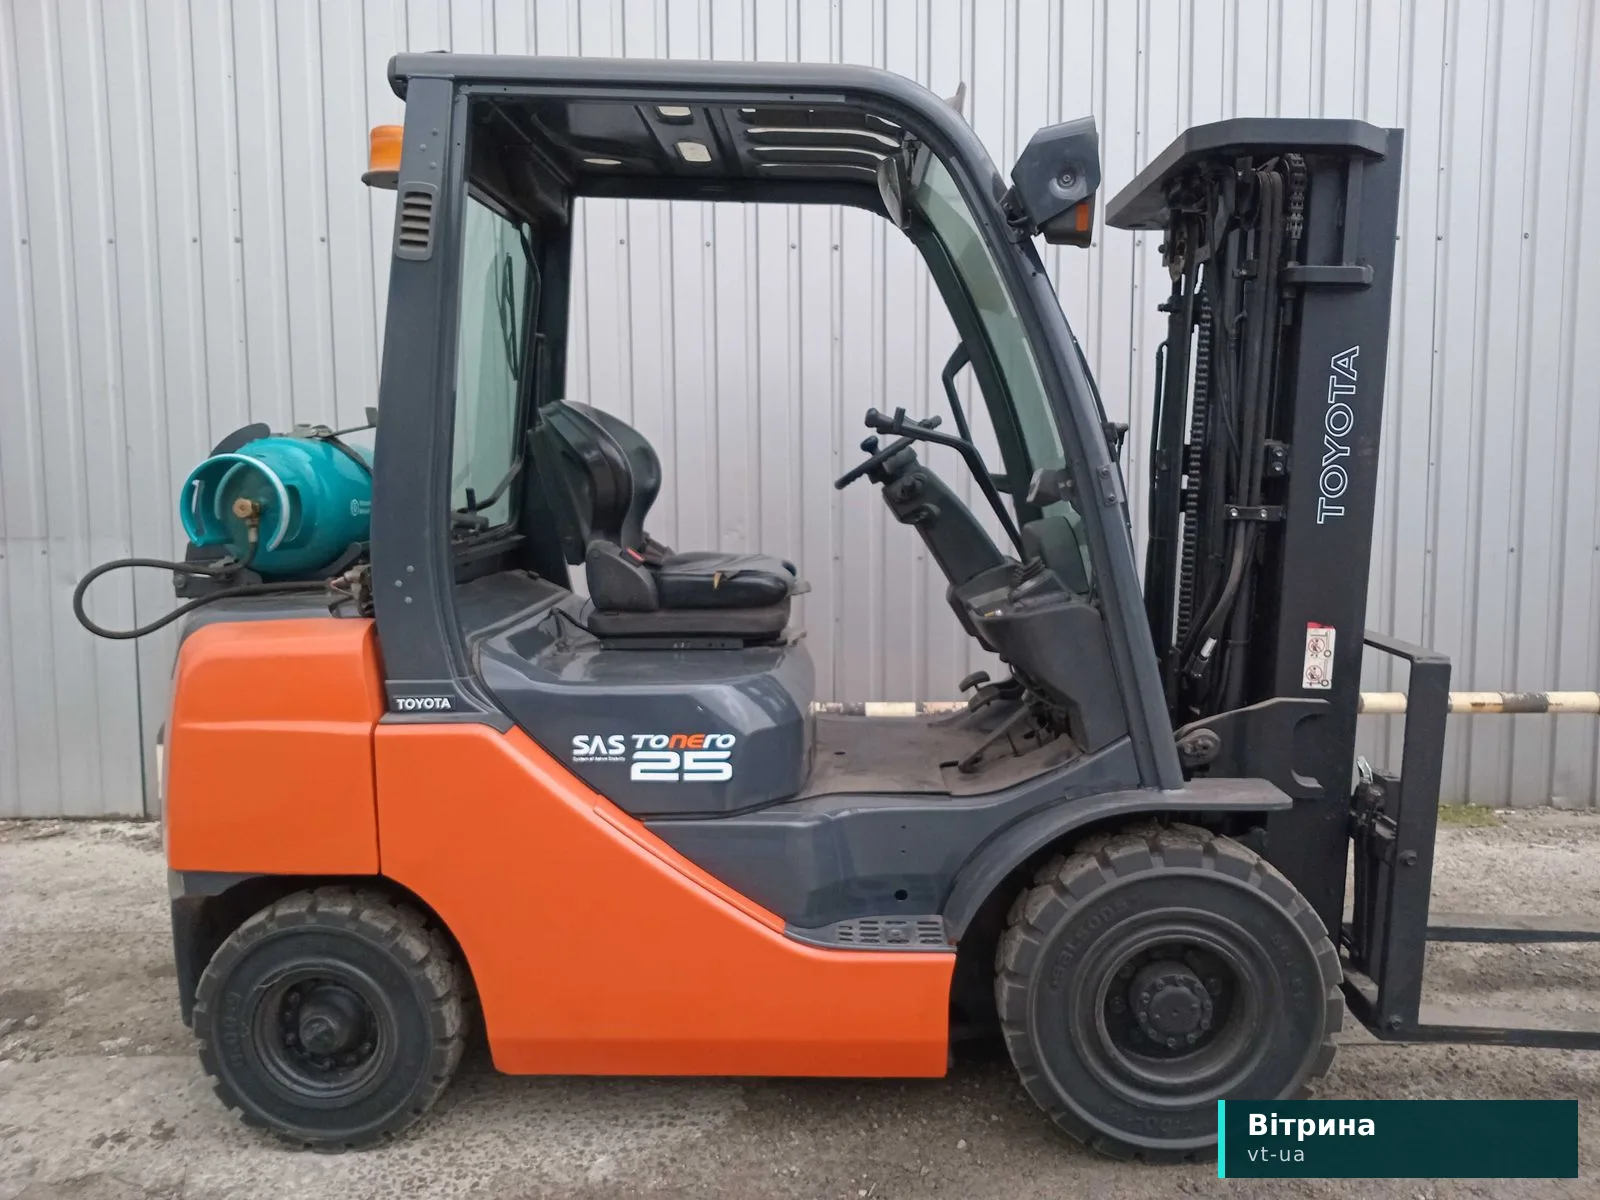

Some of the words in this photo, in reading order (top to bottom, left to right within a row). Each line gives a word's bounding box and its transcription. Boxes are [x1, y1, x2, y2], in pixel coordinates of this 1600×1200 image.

[1317, 345, 1360, 525] TOYOTA
[396, 697, 452, 710] TOYOTA
[572, 734, 626, 756] SAS
[630, 750, 733, 781] 25
